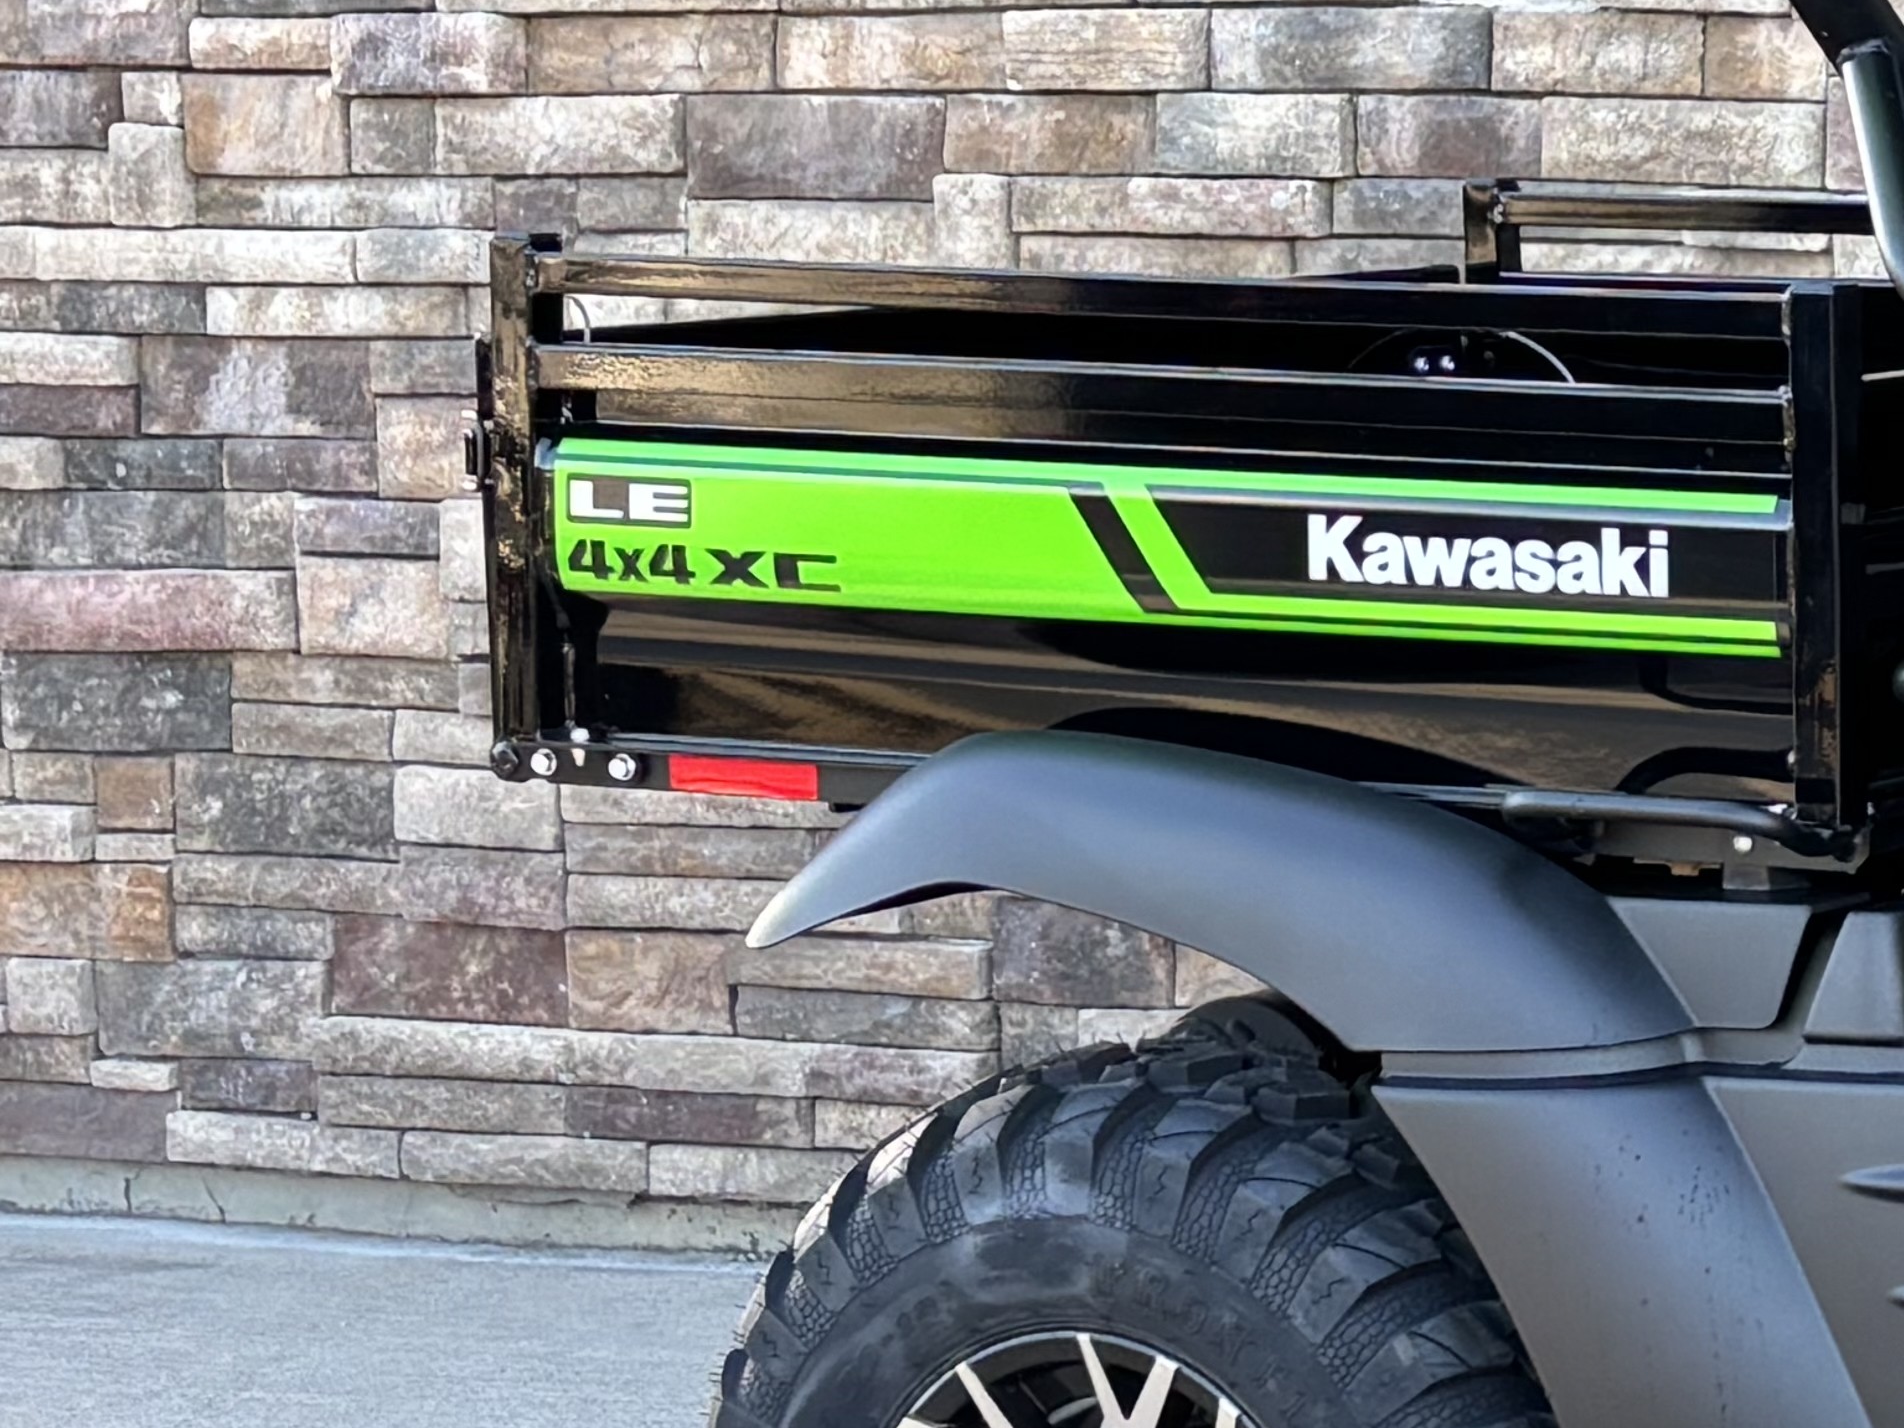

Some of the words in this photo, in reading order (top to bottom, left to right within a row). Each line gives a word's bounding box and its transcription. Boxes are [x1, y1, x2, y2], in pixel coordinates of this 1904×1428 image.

[568, 479, 690, 523] LE
[568, 538, 697, 585] 4x4
[705, 548, 842, 593] XC
[1307, 513, 1670, 599] Kawasaki
